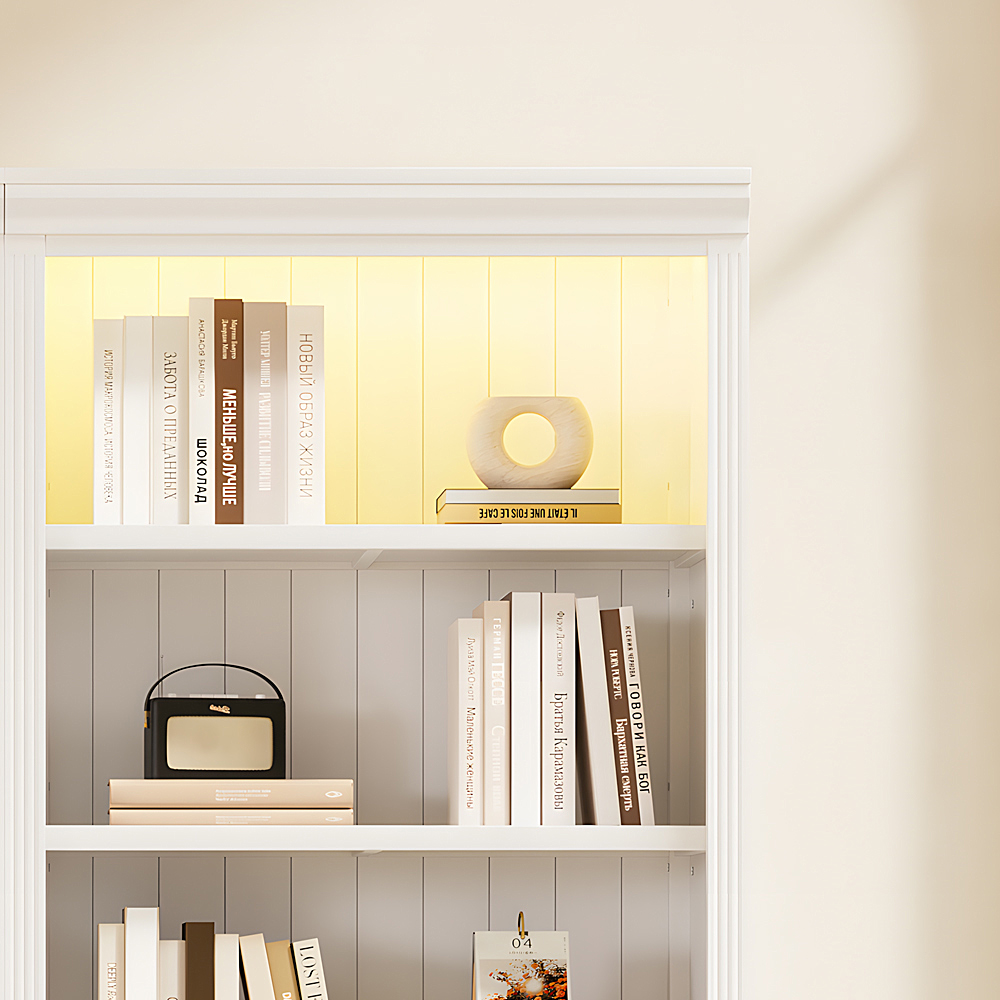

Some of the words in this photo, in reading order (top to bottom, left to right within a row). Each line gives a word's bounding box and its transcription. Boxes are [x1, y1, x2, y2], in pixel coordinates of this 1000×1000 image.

[163, 351, 177, 399] ЗАБОТА
[299, 333, 316, 387] НОВЫЙ
[164, 404, 177, 414] О
[299, 392, 313, 439] ОБРАЗ
[162, 418, 177, 500] ПРЕДАННЫХ
[195, 438, 207, 503] ШОКОЛАД
[299, 443, 313, 498] ЖИЗНИ
[222, 462, 237, 506] ЛУЧШЕ
[500, 509, 510, 518] LE
[511, 509, 529, 518] FOIS
[530, 509, 546, 518] UNE
[547, 509, 569, 520] ÉTAIT
[571, 509, 578, 518] IL
[493, 618, 502, 659] ГЕРМАН
[609, 649, 619, 668] НОРА
[491, 662, 505, 706] ГЕССЕ
[611, 669, 622, 700] РОБЕРТС
[550, 693, 568, 734] Братья
[629, 683, 644, 740] ГОВОРИ
[466, 707, 476, 761] Маленькие
[614, 718, 629, 773] Бархатная
[550, 737, 568, 810] Карамазовы
[635, 745, 647, 767] КАК
[465, 763, 475, 809] женщины
[620, 775, 633, 812] смерть
[638, 773, 650, 794] БОГ
[511, 937, 533, 949] 04
[299, 945, 320, 988] LOST
